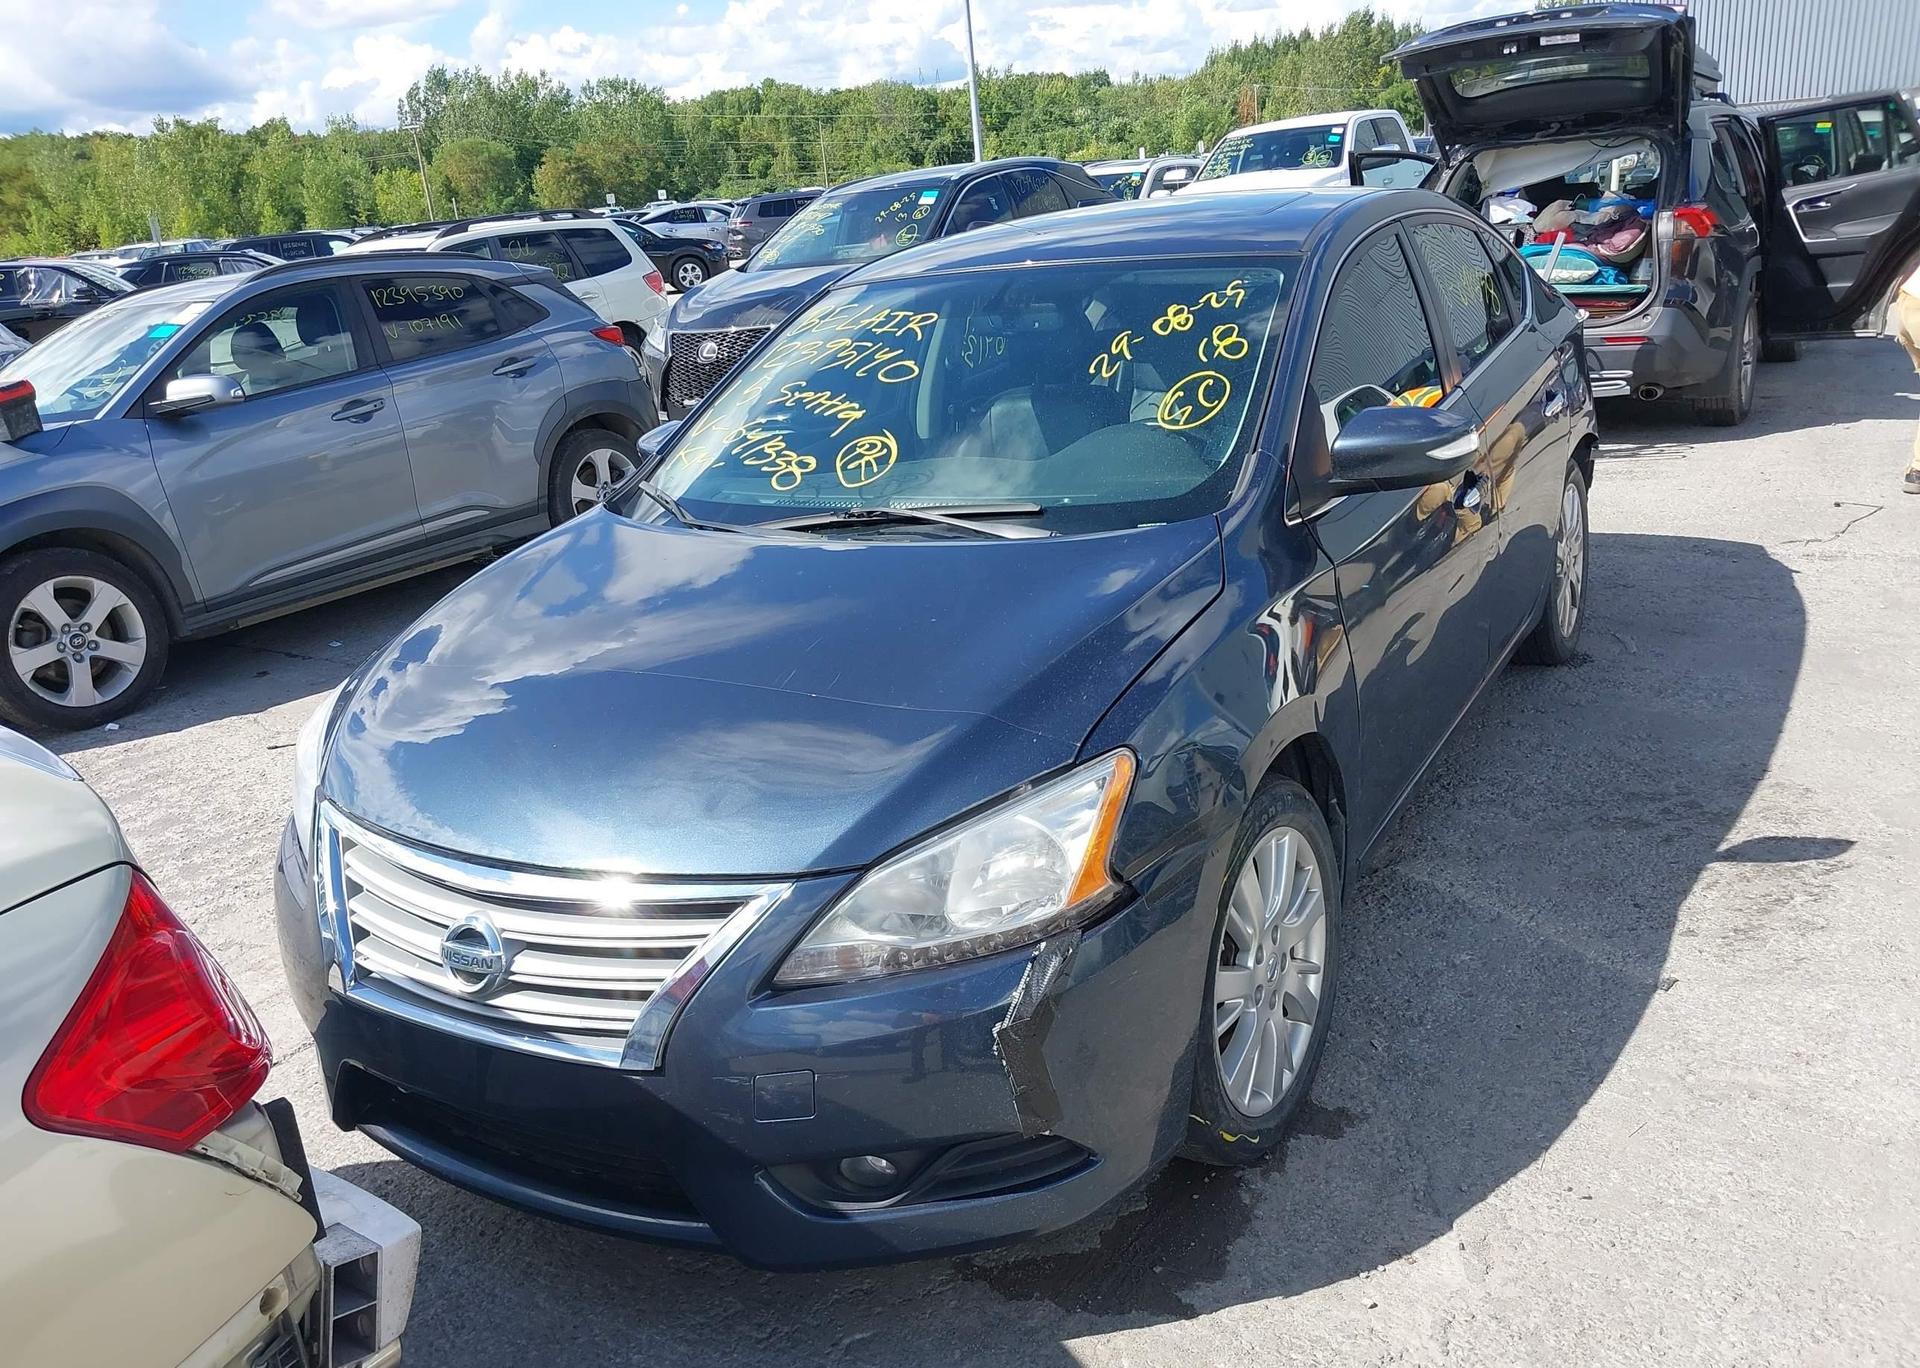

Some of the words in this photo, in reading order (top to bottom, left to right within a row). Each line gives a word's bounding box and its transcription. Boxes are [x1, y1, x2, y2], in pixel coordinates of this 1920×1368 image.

[370, 285, 465, 308] 12395390
[787, 304, 939, 341] BELAIR
[1198, 323, 1249, 362] 18
[441, 947, 494, 970] NISSAN
